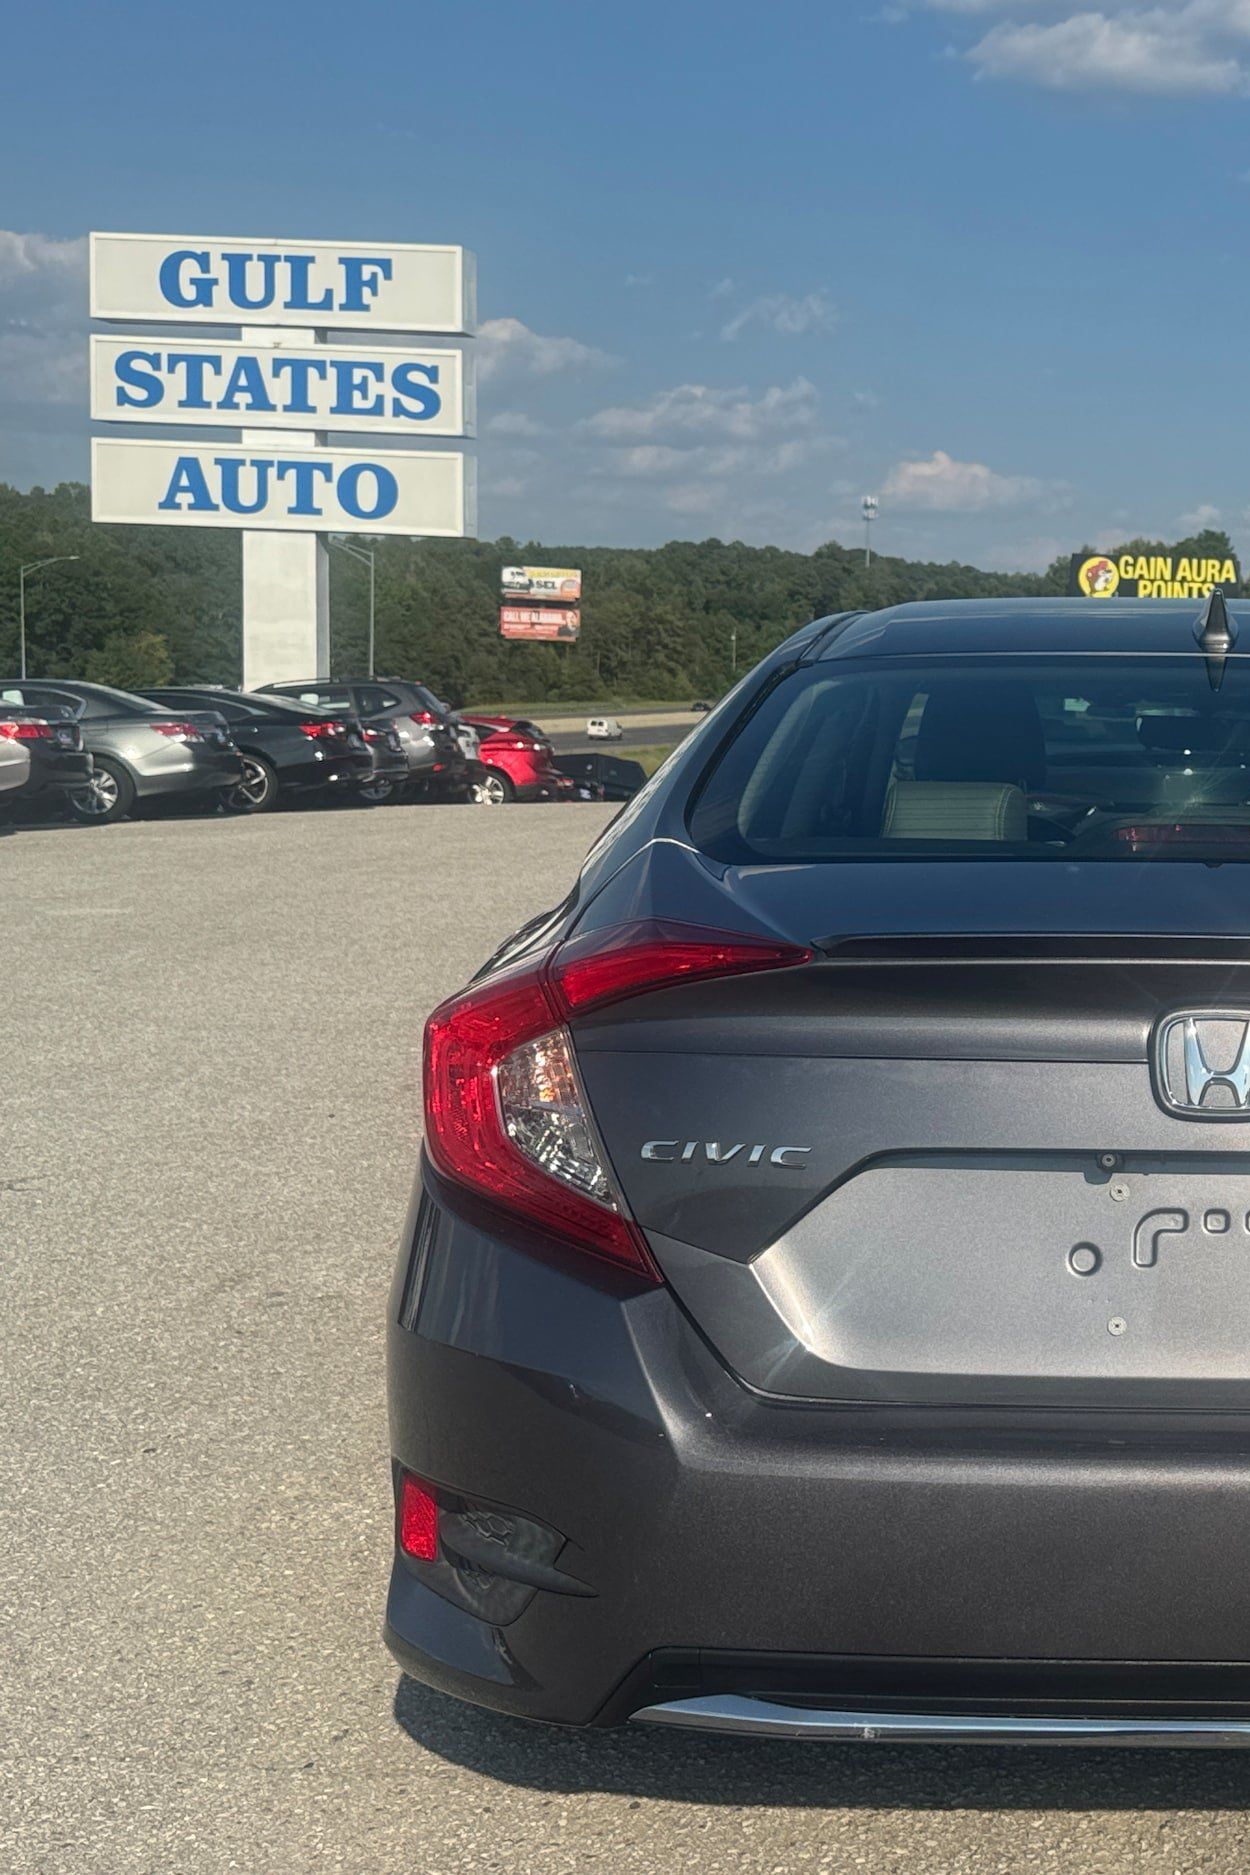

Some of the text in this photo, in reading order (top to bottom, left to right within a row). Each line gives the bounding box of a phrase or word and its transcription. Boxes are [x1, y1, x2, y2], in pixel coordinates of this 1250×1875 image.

[158, 250, 393, 312] GULF
[114, 350, 442, 421] STATES
[158, 456, 400, 520] AUTO
[1118, 555, 1237, 584] GAIN AURA
[1138, 579, 1216, 599] POINTS
[640, 1140, 812, 1169] CIVIC
